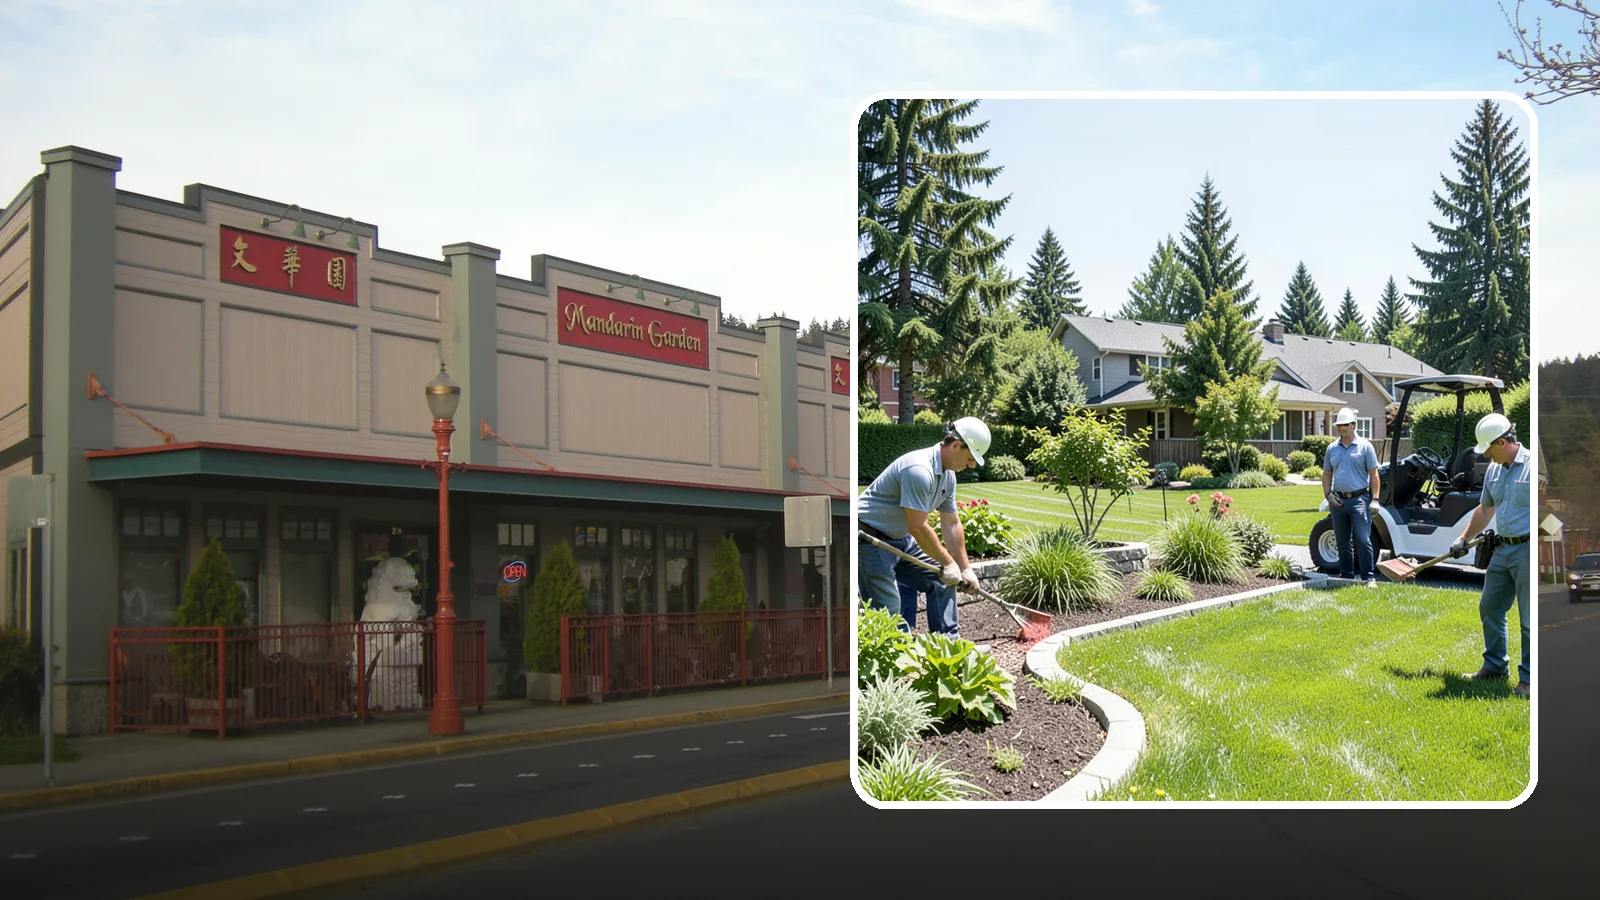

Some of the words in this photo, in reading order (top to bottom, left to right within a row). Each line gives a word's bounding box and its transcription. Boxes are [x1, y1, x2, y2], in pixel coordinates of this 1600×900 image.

[231, 236, 346, 291] 文華園
[565, 302, 644, 340] Mandarin
[648, 320, 701, 352] Garden
[503, 565, 527, 578] OPEN
